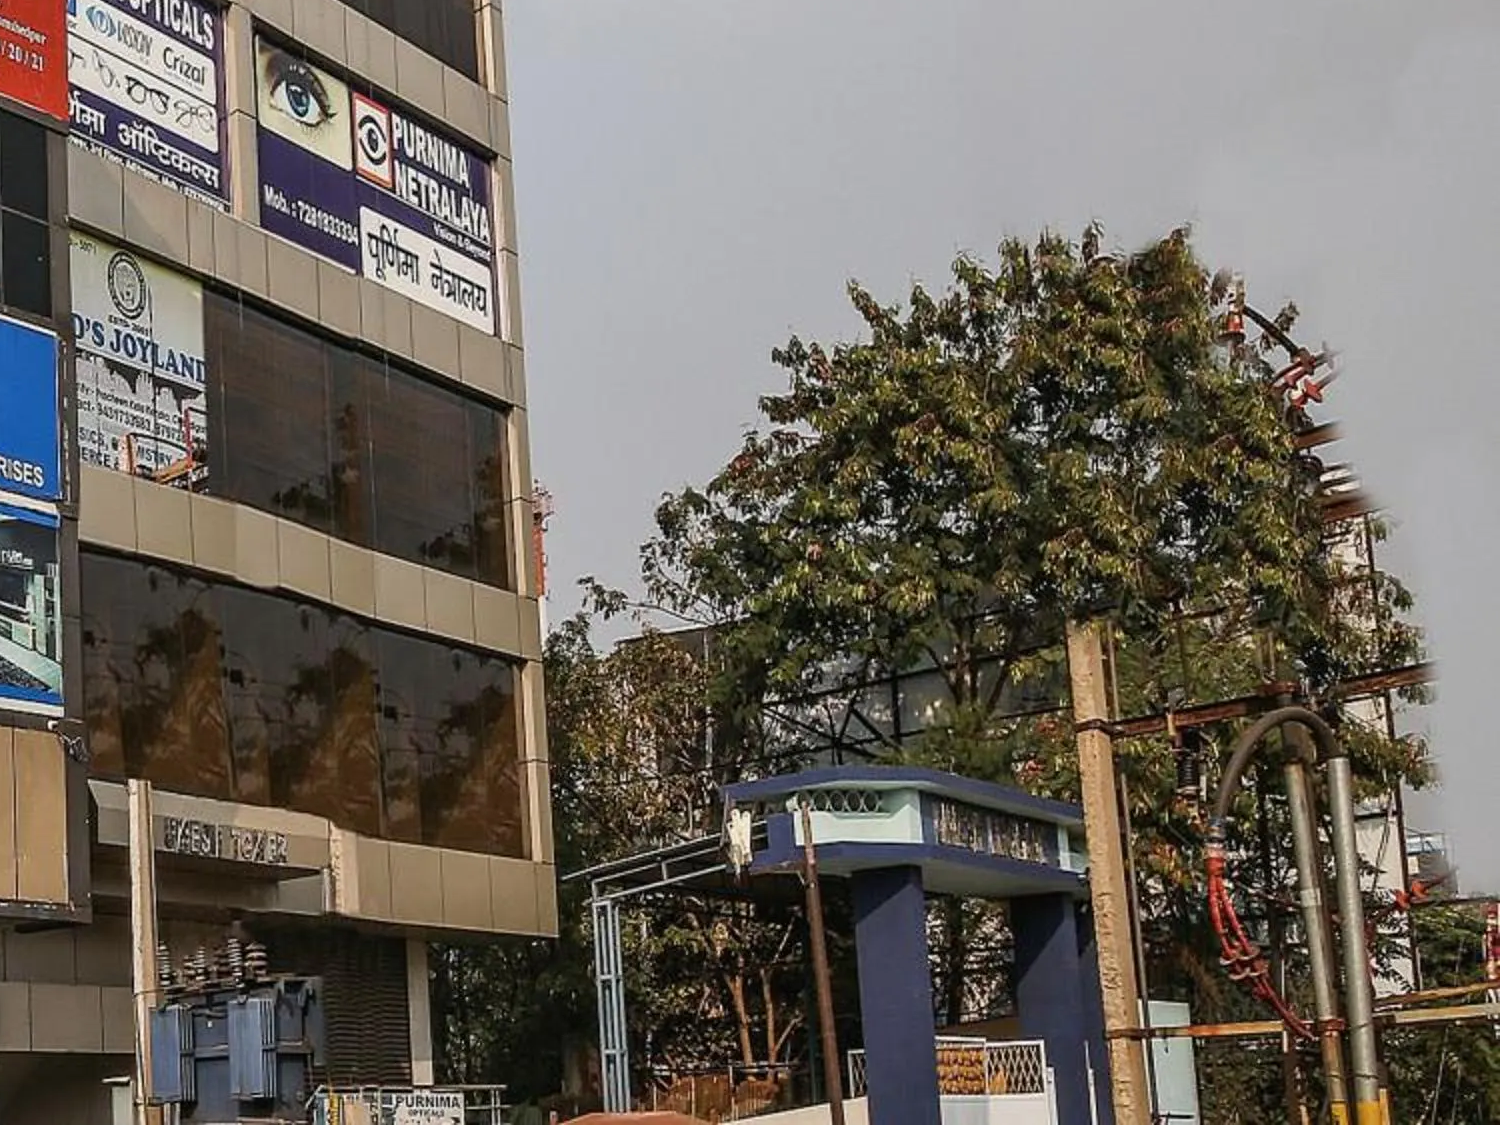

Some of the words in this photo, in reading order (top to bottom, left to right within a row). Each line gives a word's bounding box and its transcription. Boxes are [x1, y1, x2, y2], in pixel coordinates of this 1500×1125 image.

[162, 46, 206, 86] Crizal
[390, 111, 470, 190] PURNIMA
[393, 159, 491, 246] NETRALAYA
[366, 222, 421, 284] पूर्णिमा
[428, 246, 489, 318] नेत्रालय
[396, 1094, 461, 1109] PURNIMA
